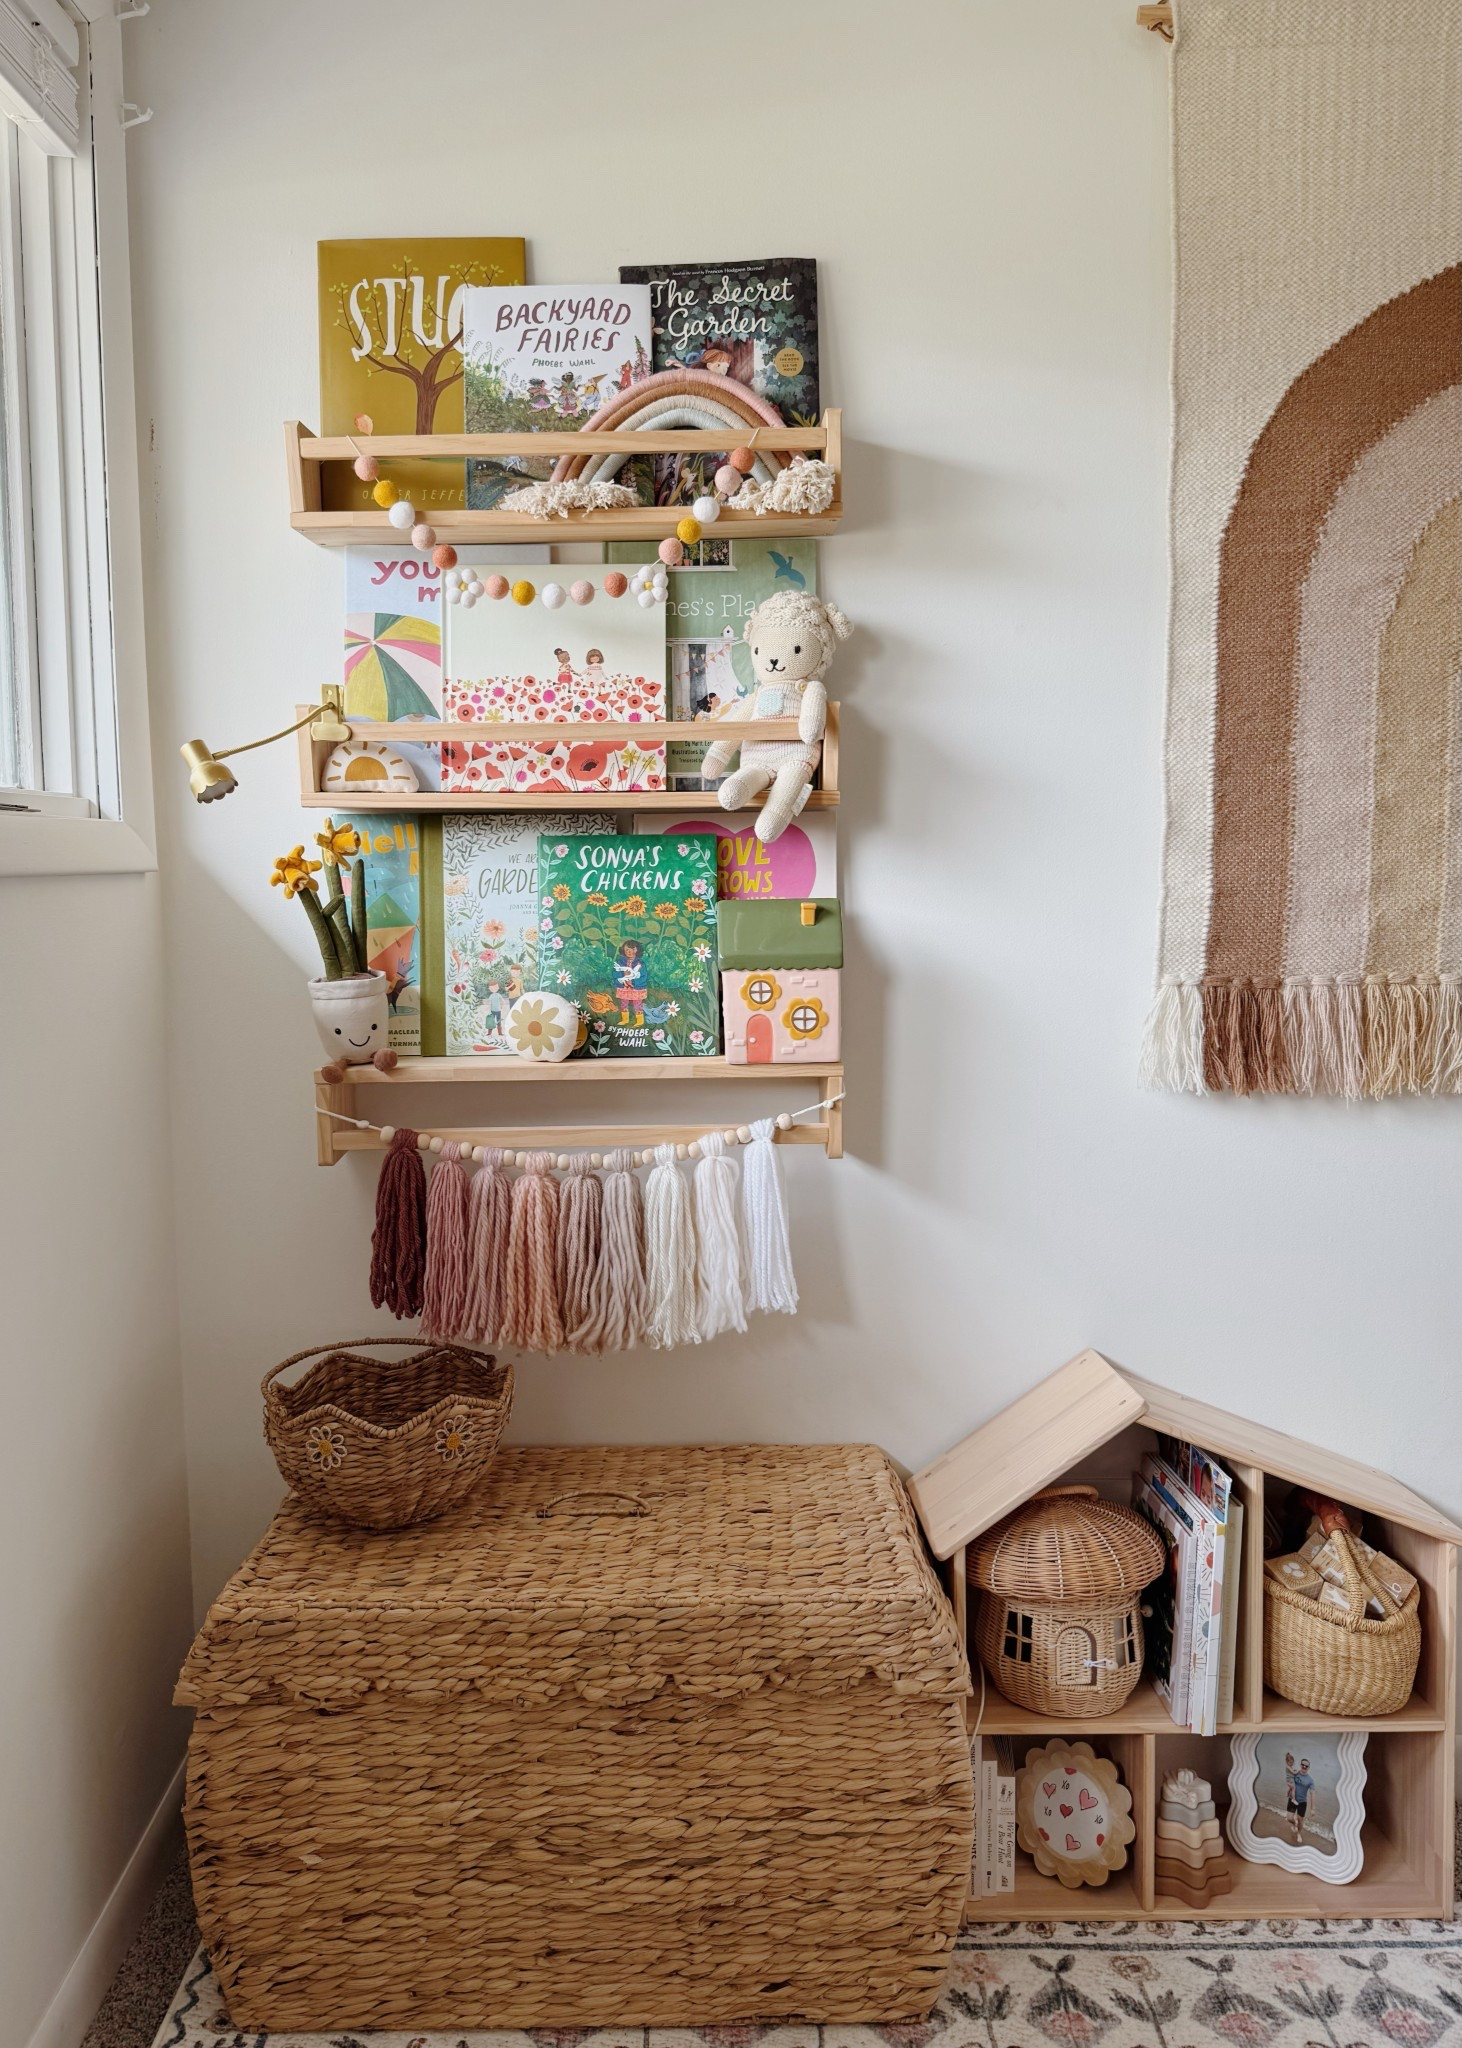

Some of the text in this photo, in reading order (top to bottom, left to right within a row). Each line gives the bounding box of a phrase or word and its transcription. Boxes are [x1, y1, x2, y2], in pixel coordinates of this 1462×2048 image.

[648, 275, 795, 308] The Secret
[496, 297, 632, 332] BACKYARD
[667, 306, 772, 350] Garden
[517, 328, 620, 353] FAIRIES
[532, 358, 596, 368] PHOEBE WAHL
[508, 854, 522, 863] WE
[574, 845, 662, 871] SONYA'S
[581, 869, 684, 892] CHICKENS
[615, 1028, 650, 1037] PHOEBE
[619, 1037, 648, 1047] WAHL
